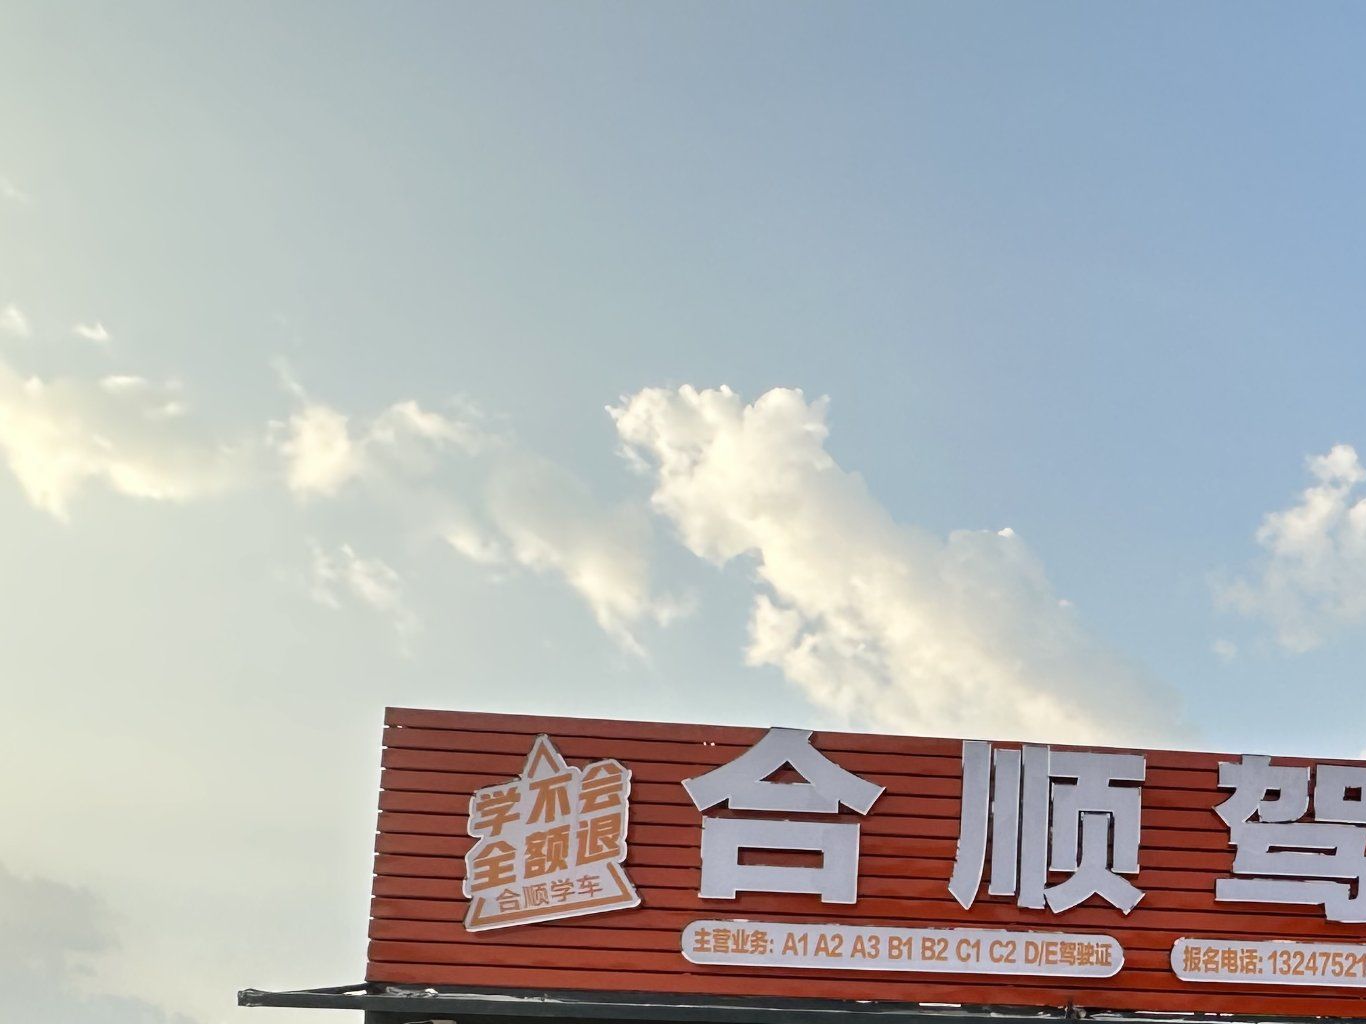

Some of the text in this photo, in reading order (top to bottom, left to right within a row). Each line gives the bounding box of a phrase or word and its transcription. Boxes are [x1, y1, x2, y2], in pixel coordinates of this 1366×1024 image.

[474, 763, 623, 837] 学不会
[471, 813, 622, 892] 全额退
[497, 874, 602, 912] 合顺学车
[782, 932, 808, 956] A1
[814, 933, 843, 957] A2
[851, 935, 880, 959] A3
[888, 936, 912, 960] B1
[921, 936, 948, 961] B2
[956, 938, 980, 962] C1
[989, 939, 1016, 963] C2
